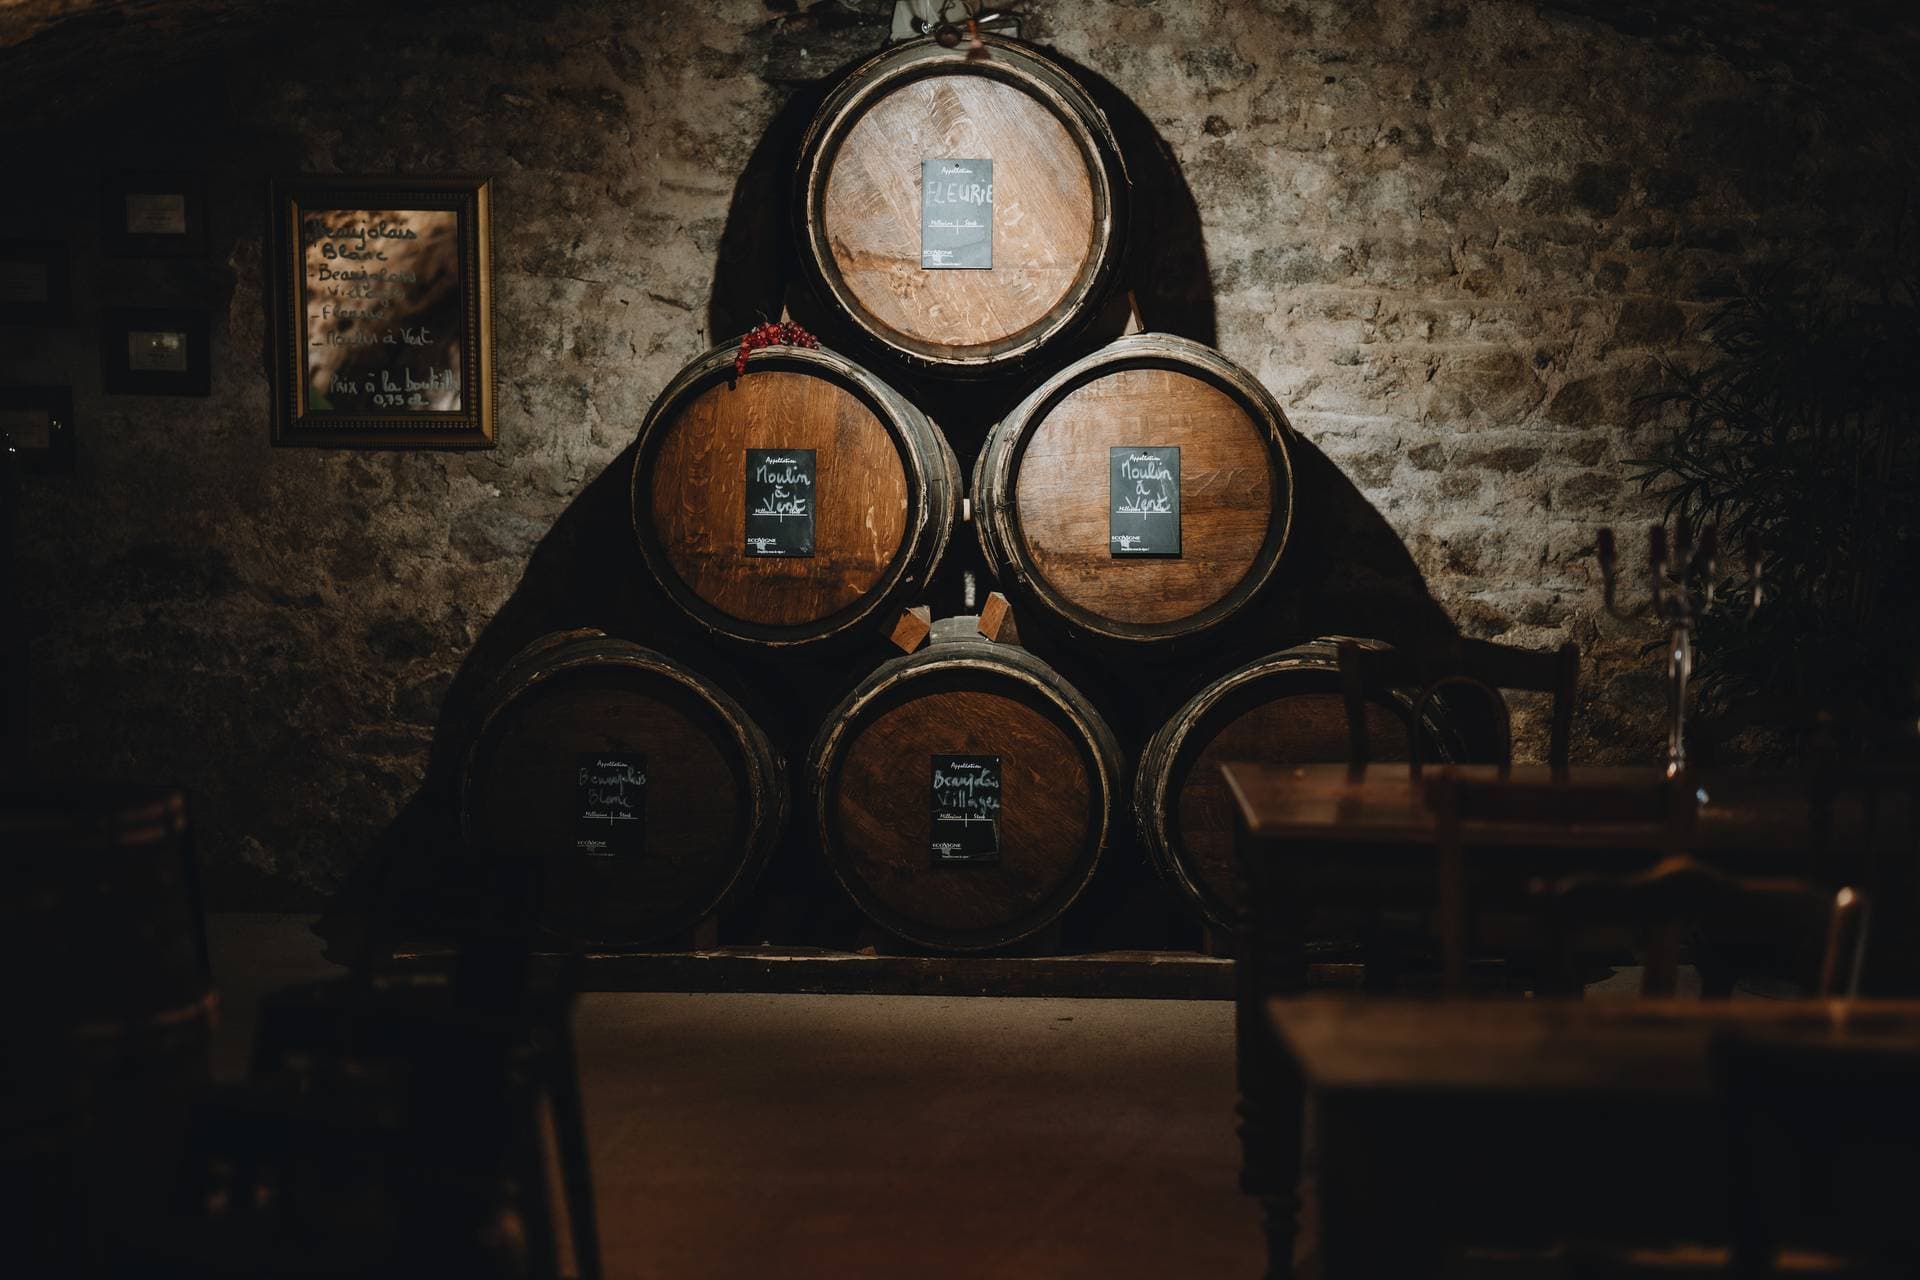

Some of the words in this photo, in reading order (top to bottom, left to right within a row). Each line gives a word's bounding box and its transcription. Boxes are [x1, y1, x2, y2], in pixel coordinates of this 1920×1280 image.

[313, 219, 417, 251] eaujolais
[322, 243, 388, 261] Blanc
[382, 329, 397, 345] à
[400, 327, 434, 346] Vent
[381, 370, 402, 393] la
[766, 456, 797, 464] Appellation
[1130, 454, 1160, 462] Appellation
[756, 465, 811, 486] Moulin
[1121, 460, 1172, 481] Moulin
[774, 485, 790, 498] à
[1135, 480, 1151, 495] à
[762, 492, 806, 513] Vent
[950, 762, 982, 770] Appellation
